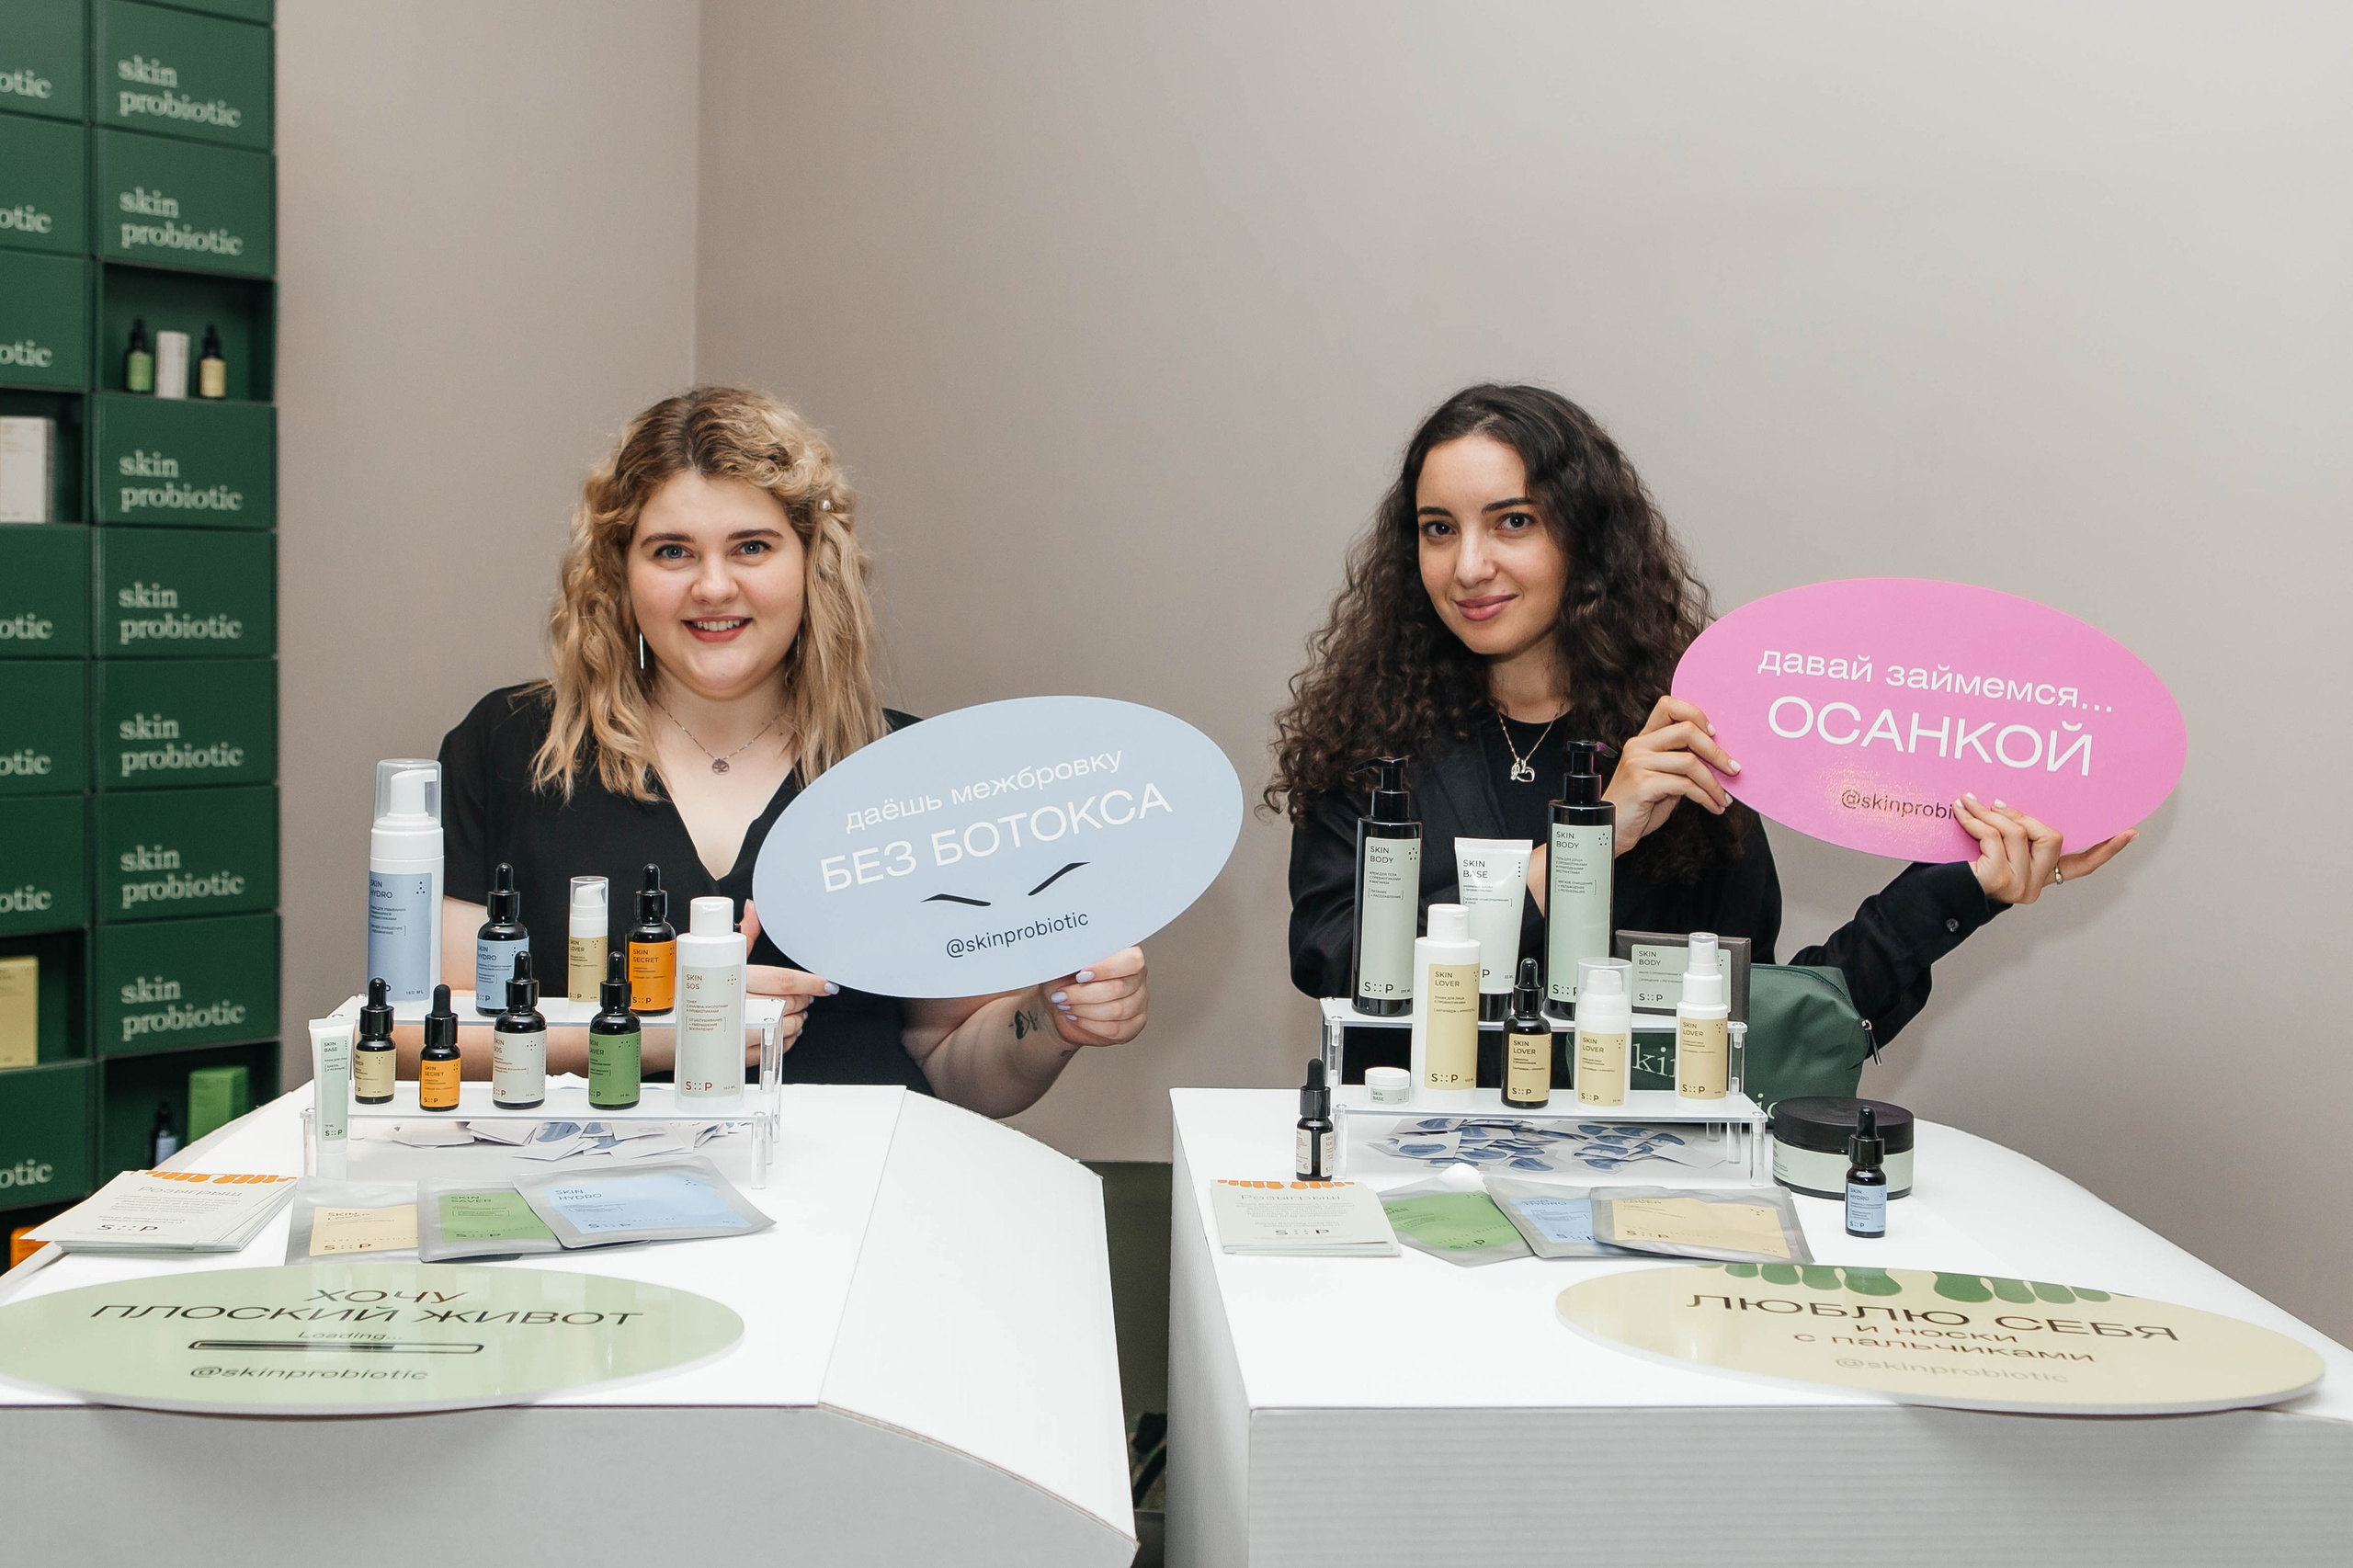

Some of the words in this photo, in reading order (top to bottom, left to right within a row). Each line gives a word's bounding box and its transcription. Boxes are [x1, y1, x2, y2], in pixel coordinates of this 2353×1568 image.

[118, 55, 177, 88] skin
[119, 90, 242, 128] probiotic
[119, 187, 179, 219] skin
[120, 222, 244, 256] probiotic
[119, 450, 178, 478] skin
[120, 483, 243, 513] probiotic
[119, 582, 178, 609] skin
[120, 613, 243, 644] probiotic
[1756, 650, 1873, 683] давай
[119, 713, 179, 740] skin
[1768, 695, 2094, 777] ОСАНКОЙ
[120, 742, 244, 774] probiotic
[846, 794, 943, 835] даёшь
[951, 750, 1123, 806] межбровку
[1841, 789, 1953, 820] @skinprobi
[821, 840, 917, 892] БЕЗ
[931, 782, 1174, 867] БОТОКСА
[1556, 831, 1574, 839] SKIN
[1556, 840, 1579, 848] BODY
[120, 844, 180, 872] skin
[1370, 846, 1390, 854] SKIN
[1370, 855, 1394, 864] BODY
[1462, 859, 1485, 868] SKIN
[121, 871, 245, 909] probiotic
[946, 911, 1090, 959] @skinprobiotic
[120, 976, 181, 1005] skin
[686, 973, 703, 982] SKIN
[121, 1001, 245, 1042] probiotic
[1582, 1045, 1605, 1053] LOVER
[559, 1192, 603, 1201] HYDRO
[305, 1289, 469, 1304] ХОЧУ
[90, 1305, 401, 1323] ПЛОСКИЙ
[413, 1309, 644, 1326] ЖИВОТ
[1686, 1294, 1971, 1326] ЛЮБЛЮ
[1994, 1315, 2180, 1342] СЕБЯ
[1794, 1334, 1816, 1343] с
[1831, 1335, 2096, 1363] пальчиками
[1855, 1324, 1879, 1334] и
[1894, 1327, 2018, 1344] носки
[189, 1366, 429, 1381] @skinprobiotic
[1835, 1358, 2070, 1384] @skinprobiotic
